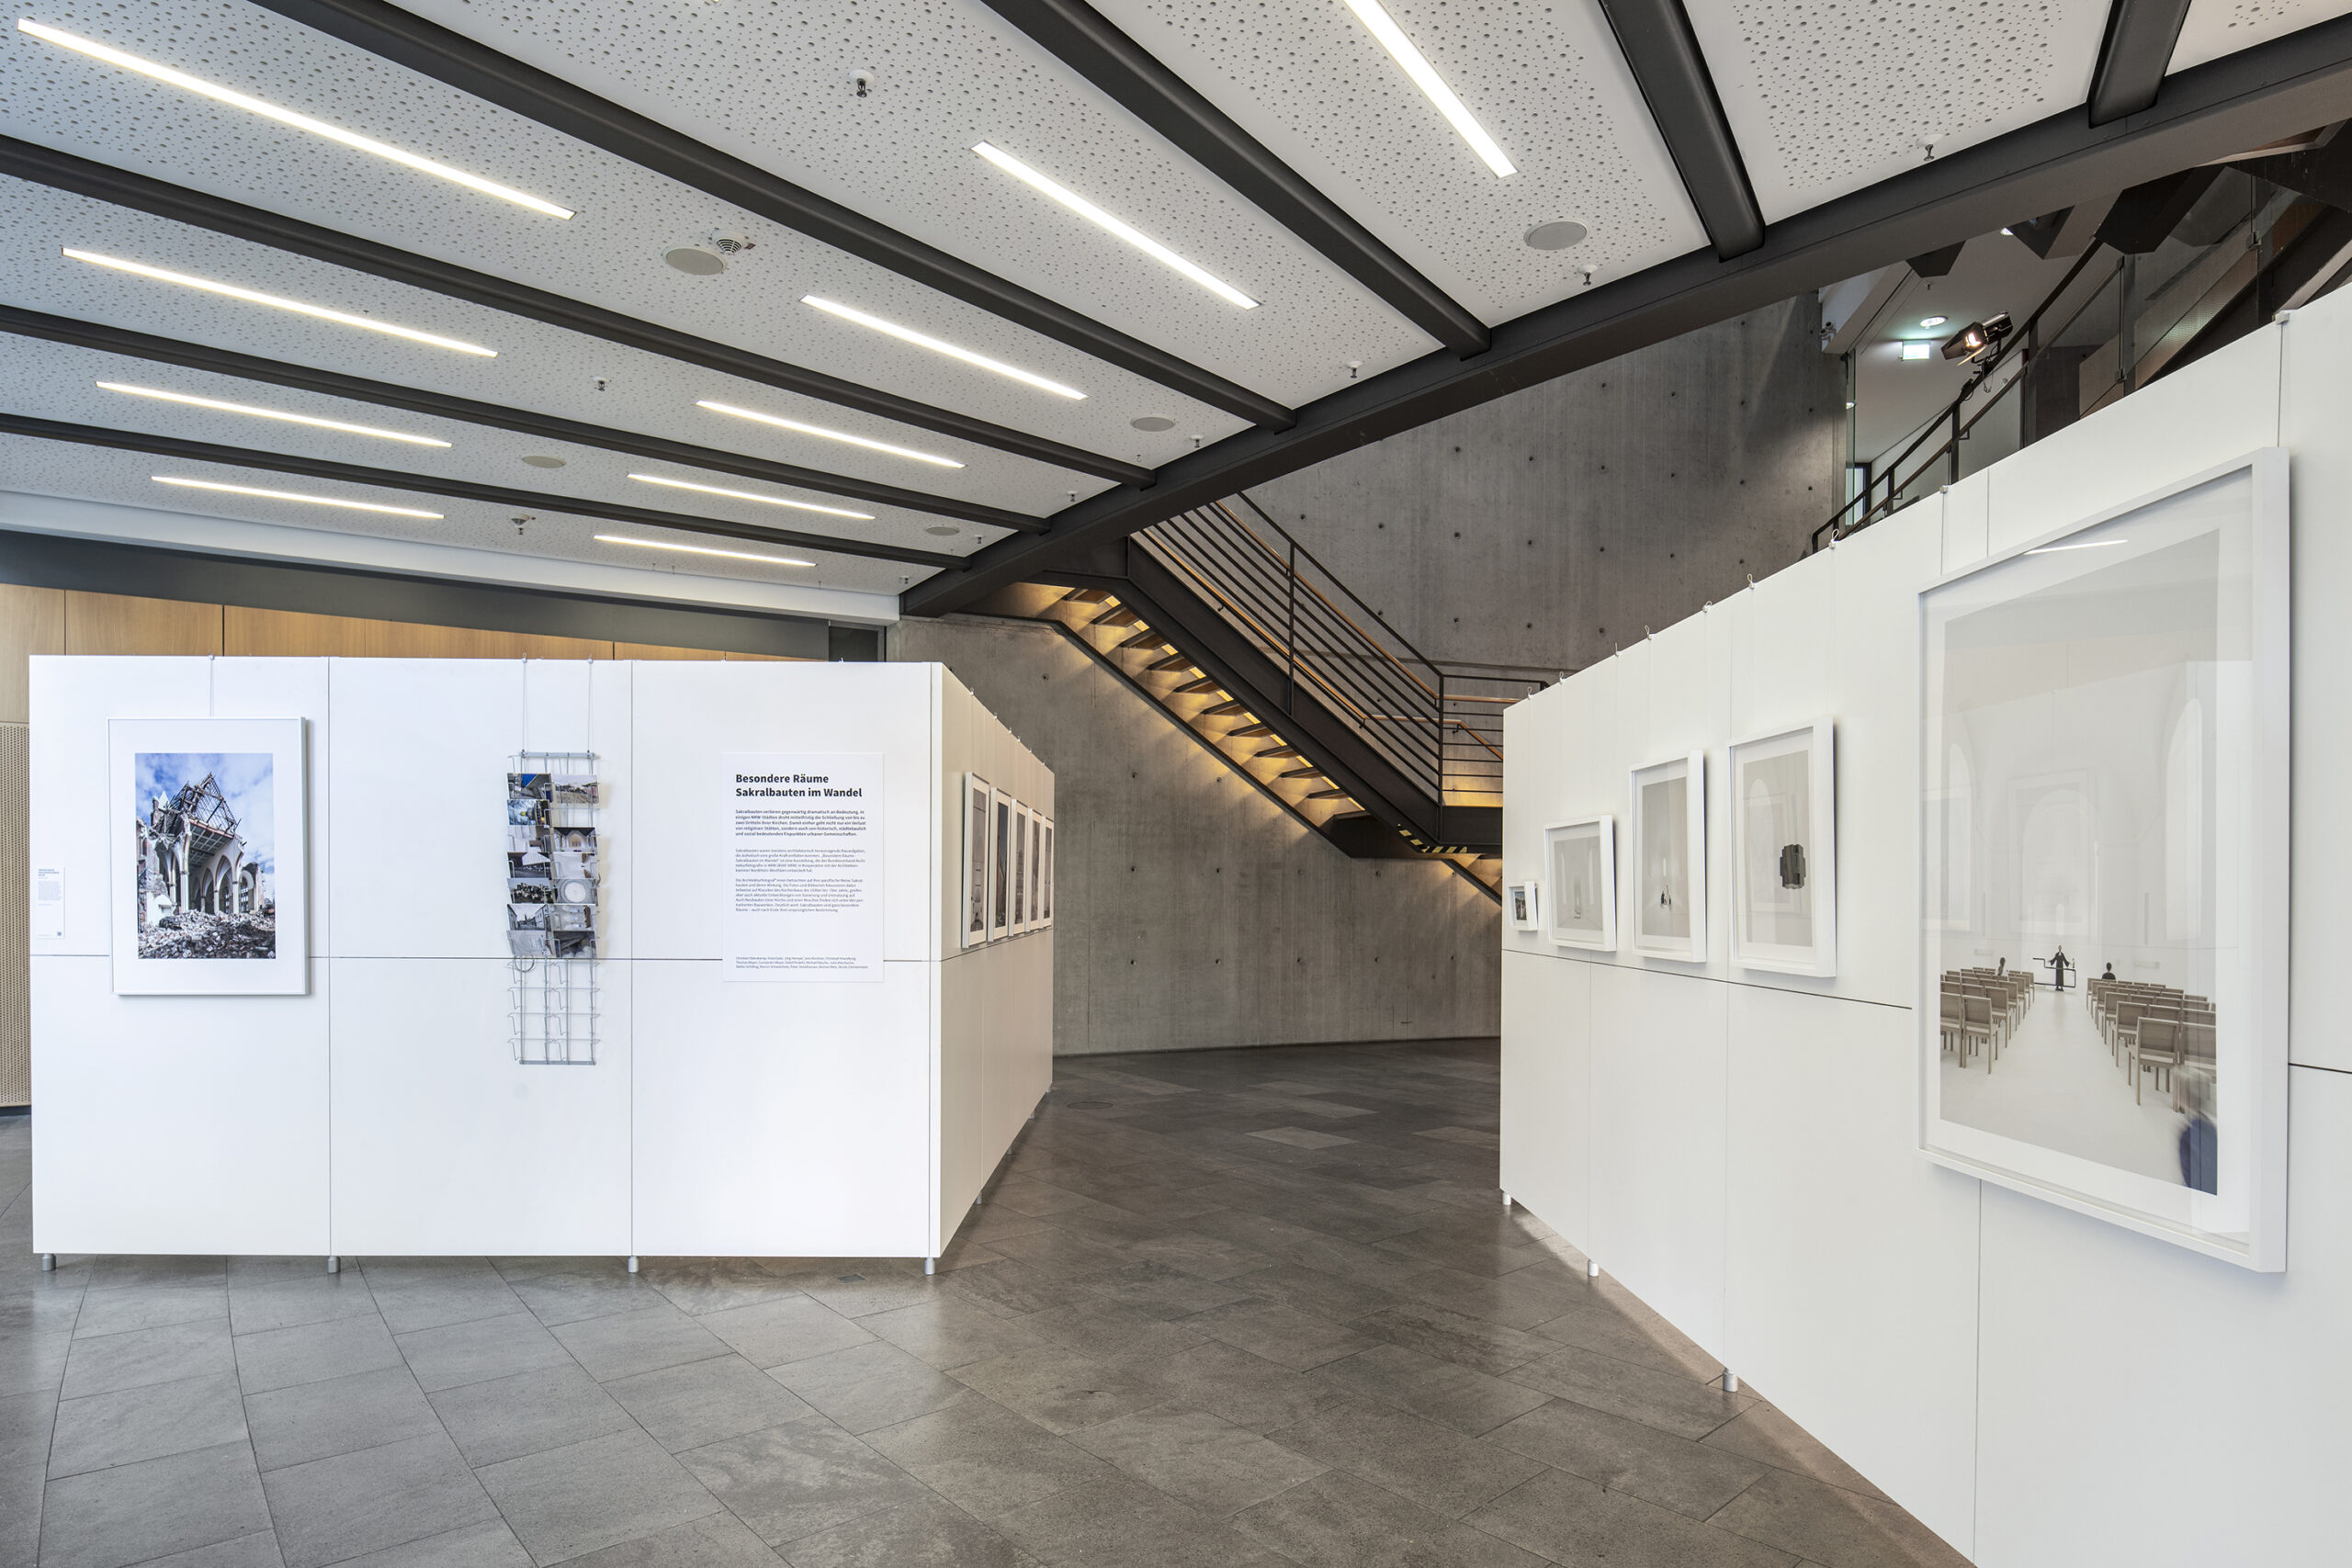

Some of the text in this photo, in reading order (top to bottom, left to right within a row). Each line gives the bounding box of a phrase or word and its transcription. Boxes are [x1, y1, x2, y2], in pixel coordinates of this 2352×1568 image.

[735, 773, 829, 783] Besondere Räume
[735, 788, 862, 797] Sakralbauten im Wandel
